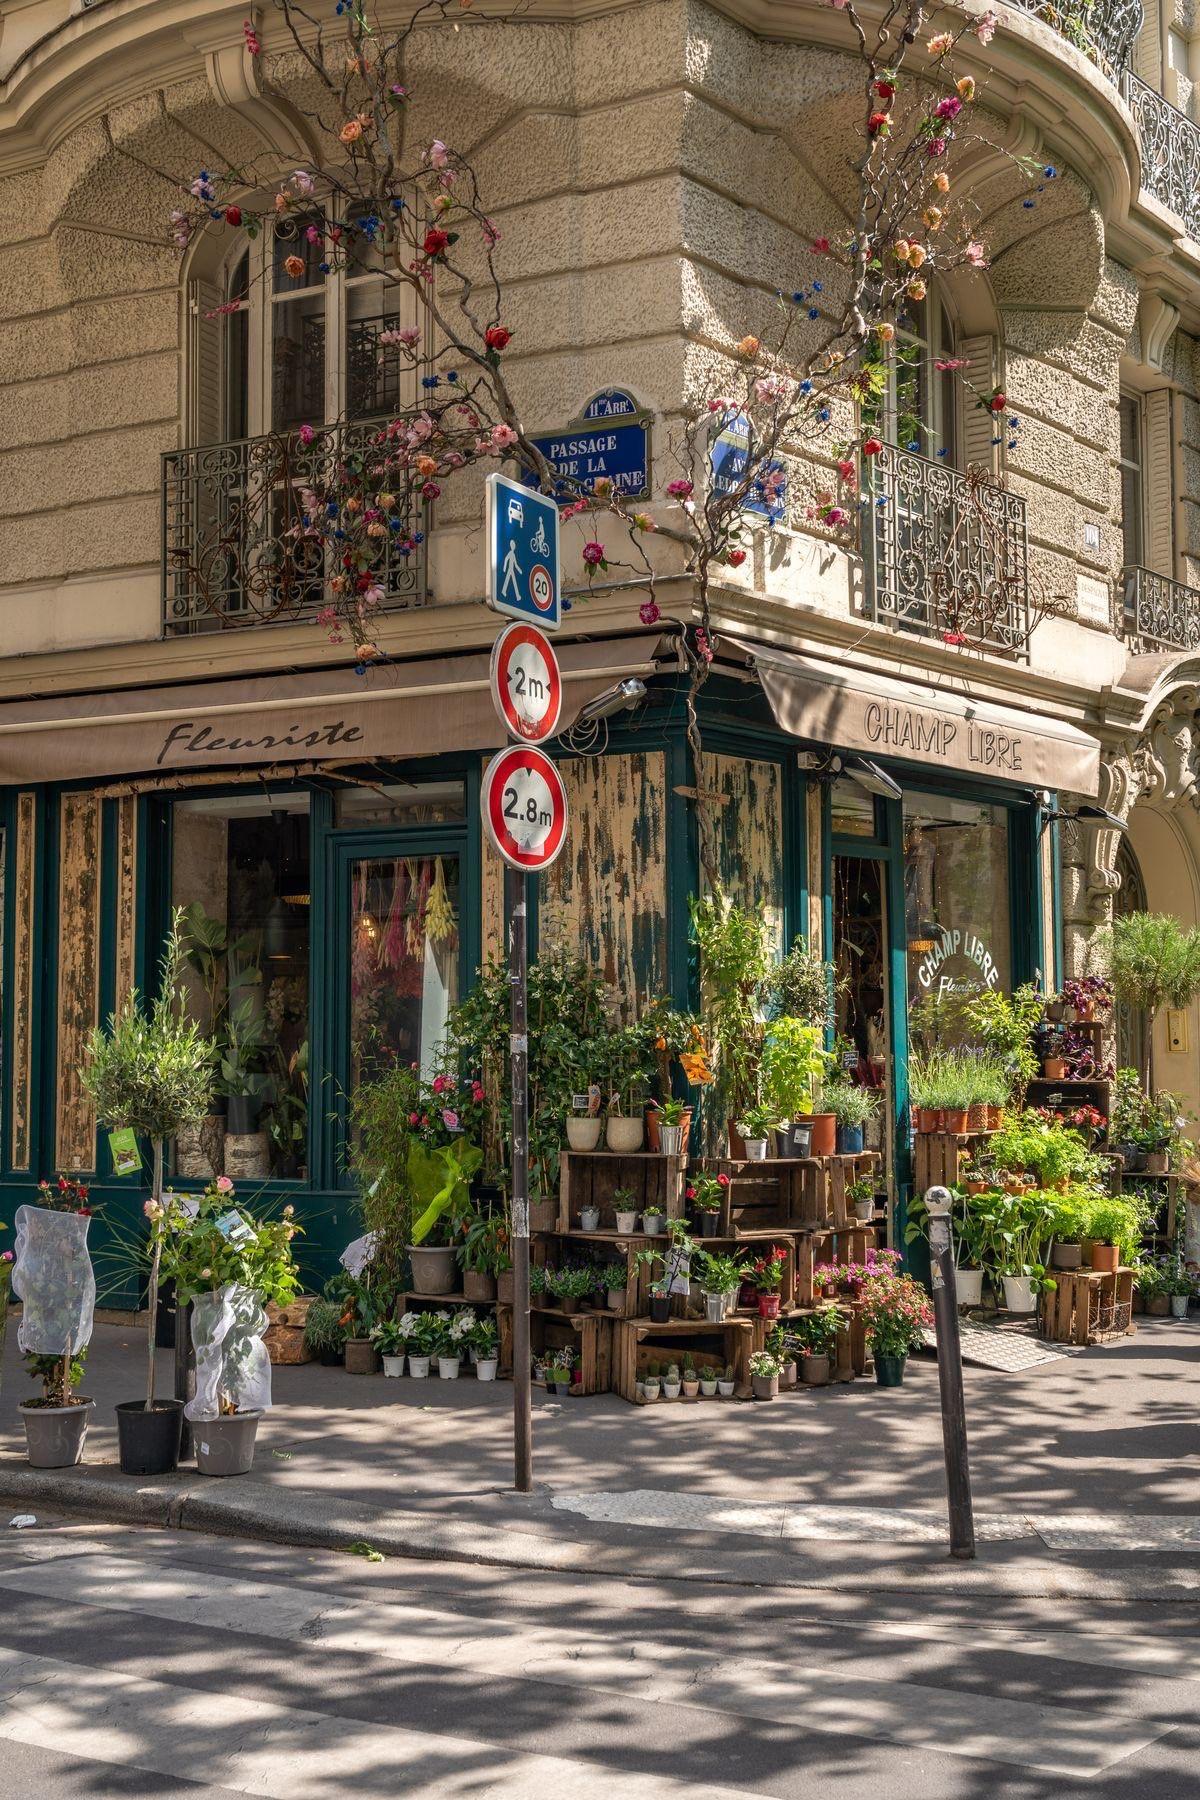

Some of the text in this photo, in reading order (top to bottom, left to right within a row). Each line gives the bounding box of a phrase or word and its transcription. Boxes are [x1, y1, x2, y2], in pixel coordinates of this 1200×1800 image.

[550, 435, 617, 459] PASSAGE
[559, 457, 606, 477] DE LA
[535, 577, 548, 596] 20
[157, 721, 364, 765] Fleuriste
[864, 702, 1023, 771] CHAMP LIBRE
[918, 929, 999, 989] CHAMP LIBRE
